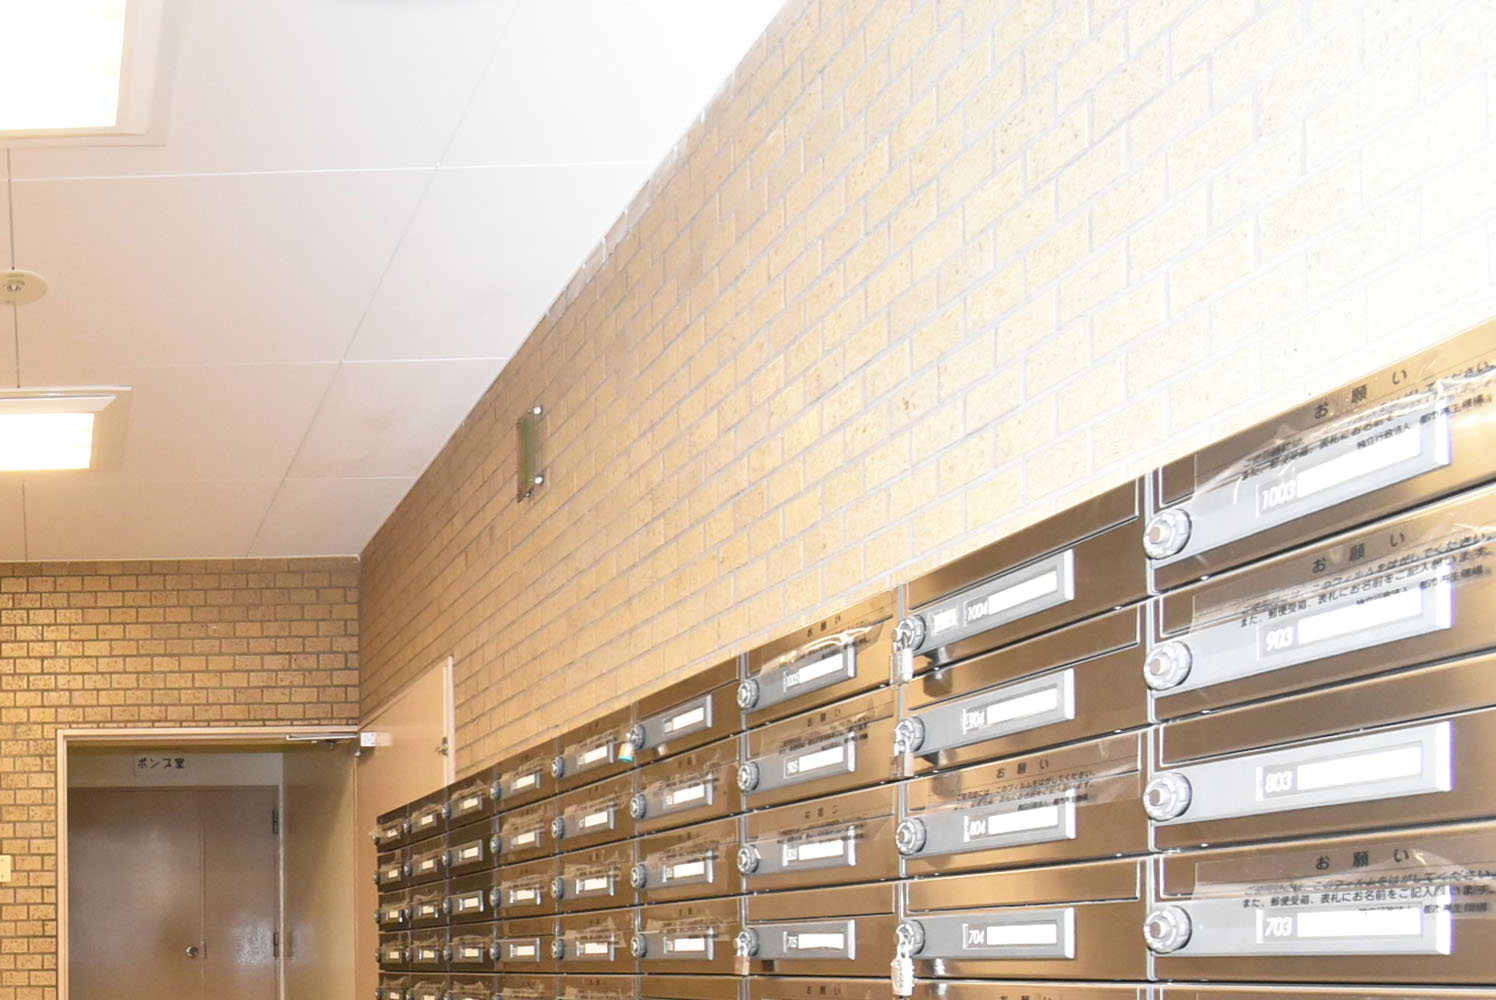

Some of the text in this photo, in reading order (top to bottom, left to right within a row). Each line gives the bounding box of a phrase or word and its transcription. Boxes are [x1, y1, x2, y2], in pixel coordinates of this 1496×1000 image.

[1314, 370, 1407, 420] お願い
[1312, 532, 1404, 574] お願い
[1265, 626, 1294, 651] 903
[1265, 770, 1293, 793] 803
[969, 820, 986, 835] 804
[1315, 849, 1409, 871] お願い
[968, 930, 984, 944] 704
[1265, 917, 1293, 937] 703
